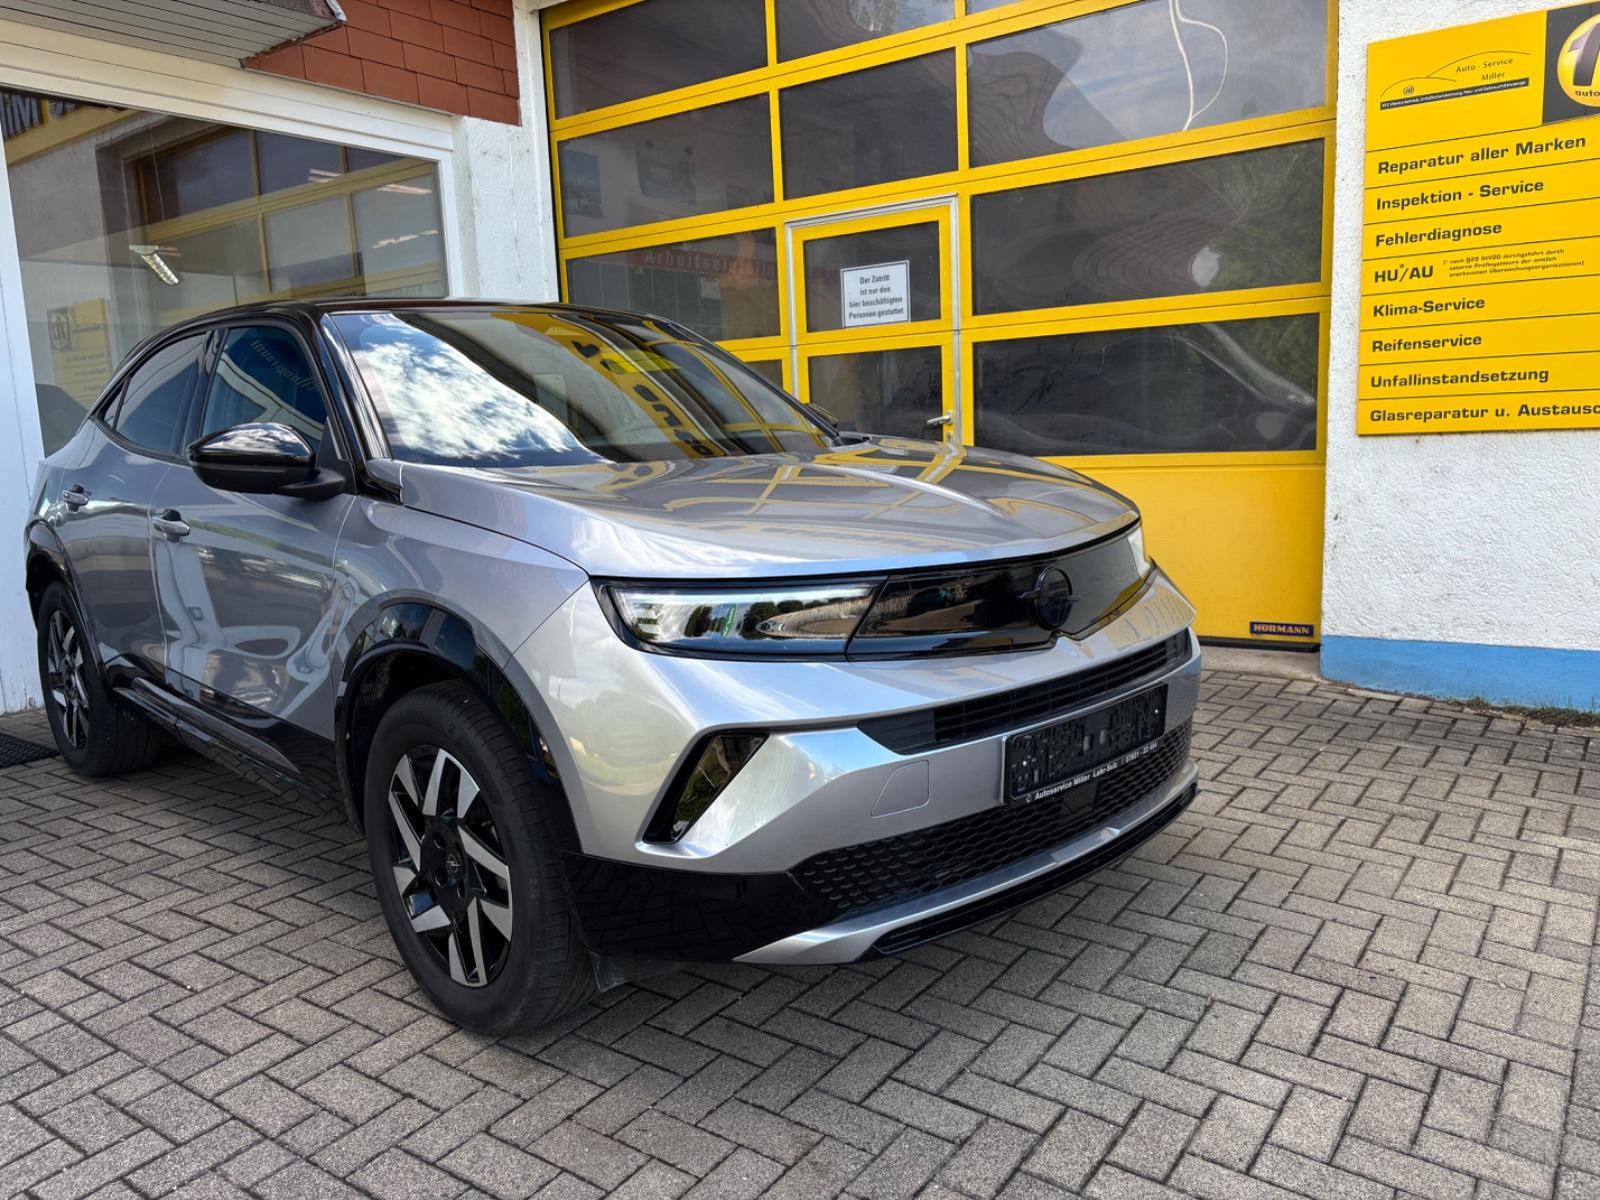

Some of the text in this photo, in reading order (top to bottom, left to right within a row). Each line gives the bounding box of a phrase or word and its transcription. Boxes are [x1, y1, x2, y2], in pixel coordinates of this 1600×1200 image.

[1456, 64, 1475, 73] Auto
[1482, 57, 1513, 69] Service
[1481, 71, 1505, 81] Miller
[1378, 137, 1586, 175] Reparatur aller Marken
[1376, 190, 1462, 211] Inspektion
[1479, 180, 1544, 198] Service
[1375, 224, 1502, 247] Fehlerdiagnose
[859, 274, 890, 284] Der Zutritt
[848, 307, 904, 319] Personen gestattet
[1373, 298, 1485, 317] Klima-Service
[1372, 334, 1482, 352] Reifenservice
[1370, 369, 1549, 388] Unfallinstandsetzung
[1370, 404, 1600, 423] Glasreparatur u. Austausc
[1034, 780, 1073, 800] Autoservice
[1073, 773, 1090, 785] Miller
